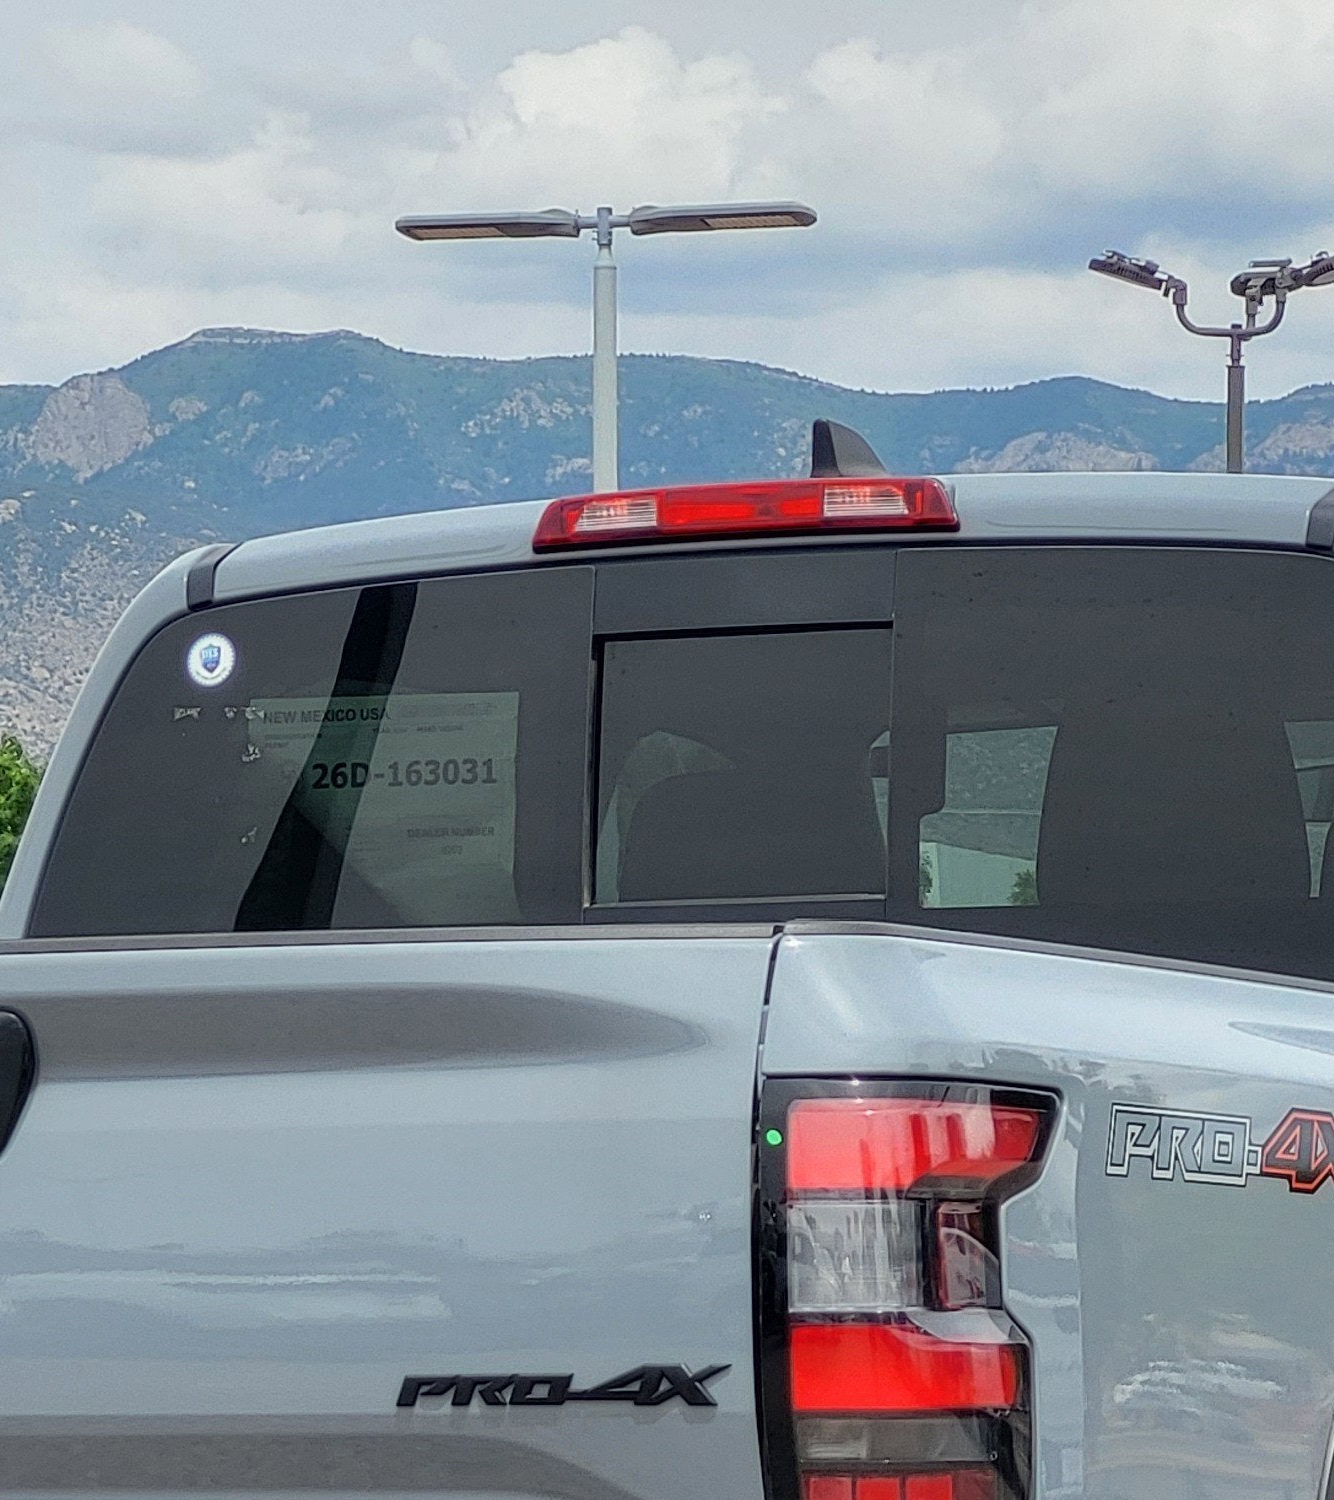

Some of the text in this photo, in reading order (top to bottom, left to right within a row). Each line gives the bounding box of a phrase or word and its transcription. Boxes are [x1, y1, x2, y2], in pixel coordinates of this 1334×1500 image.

[263, 711, 296, 725] NEW
[300, 708, 357, 724] MEXICO
[311, 758, 498, 790] 26D-163031
